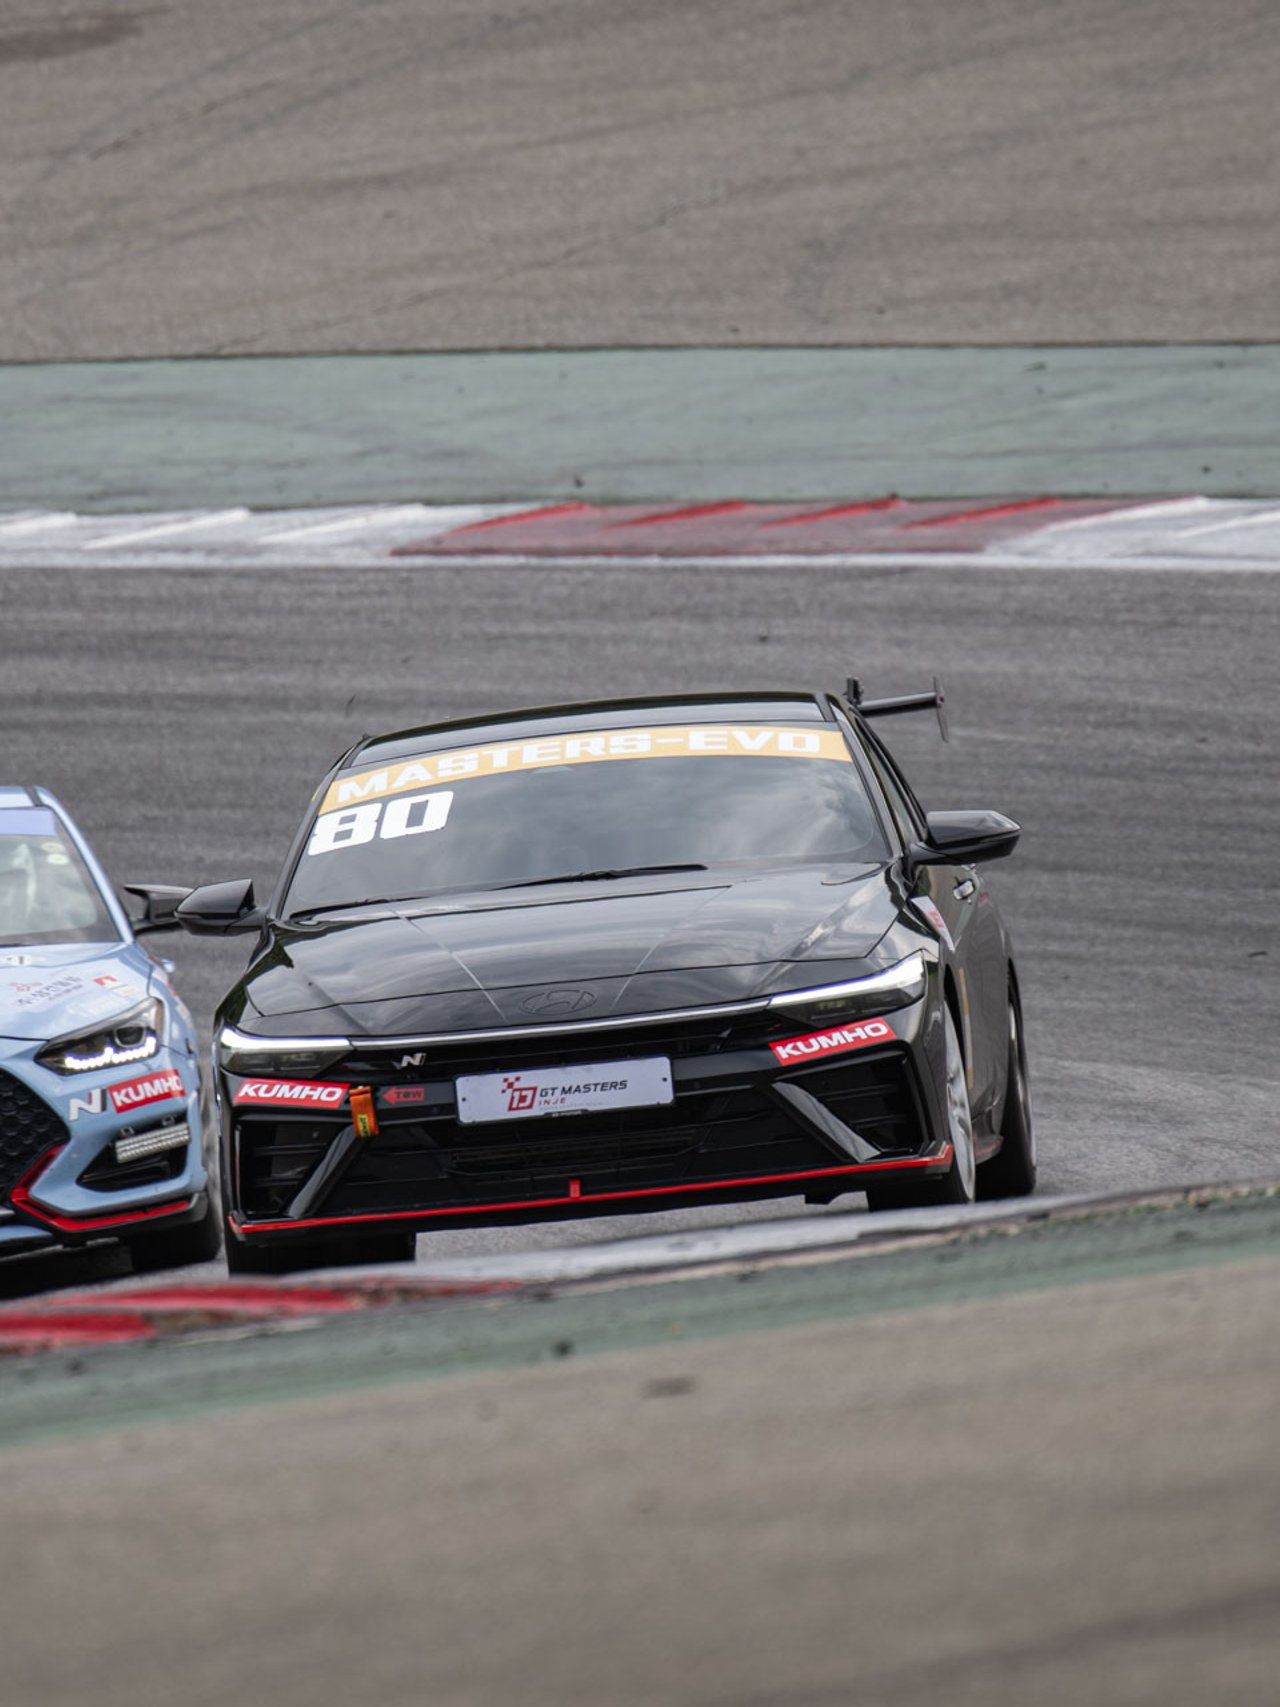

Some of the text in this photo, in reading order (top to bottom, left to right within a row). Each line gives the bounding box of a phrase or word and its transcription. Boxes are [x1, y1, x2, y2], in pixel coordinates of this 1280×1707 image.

[336, 731, 821, 803] MASTERS-EVO
[308, 790, 455, 856] 80
[775, 1022, 889, 1059] KUMHO
[112, 1075, 184, 1107] KUMHO
[239, 1083, 343, 1102] KUMHO
[539, 1080, 628, 1098] GT MASTERS
[539, 1097, 566, 1106] INJE
